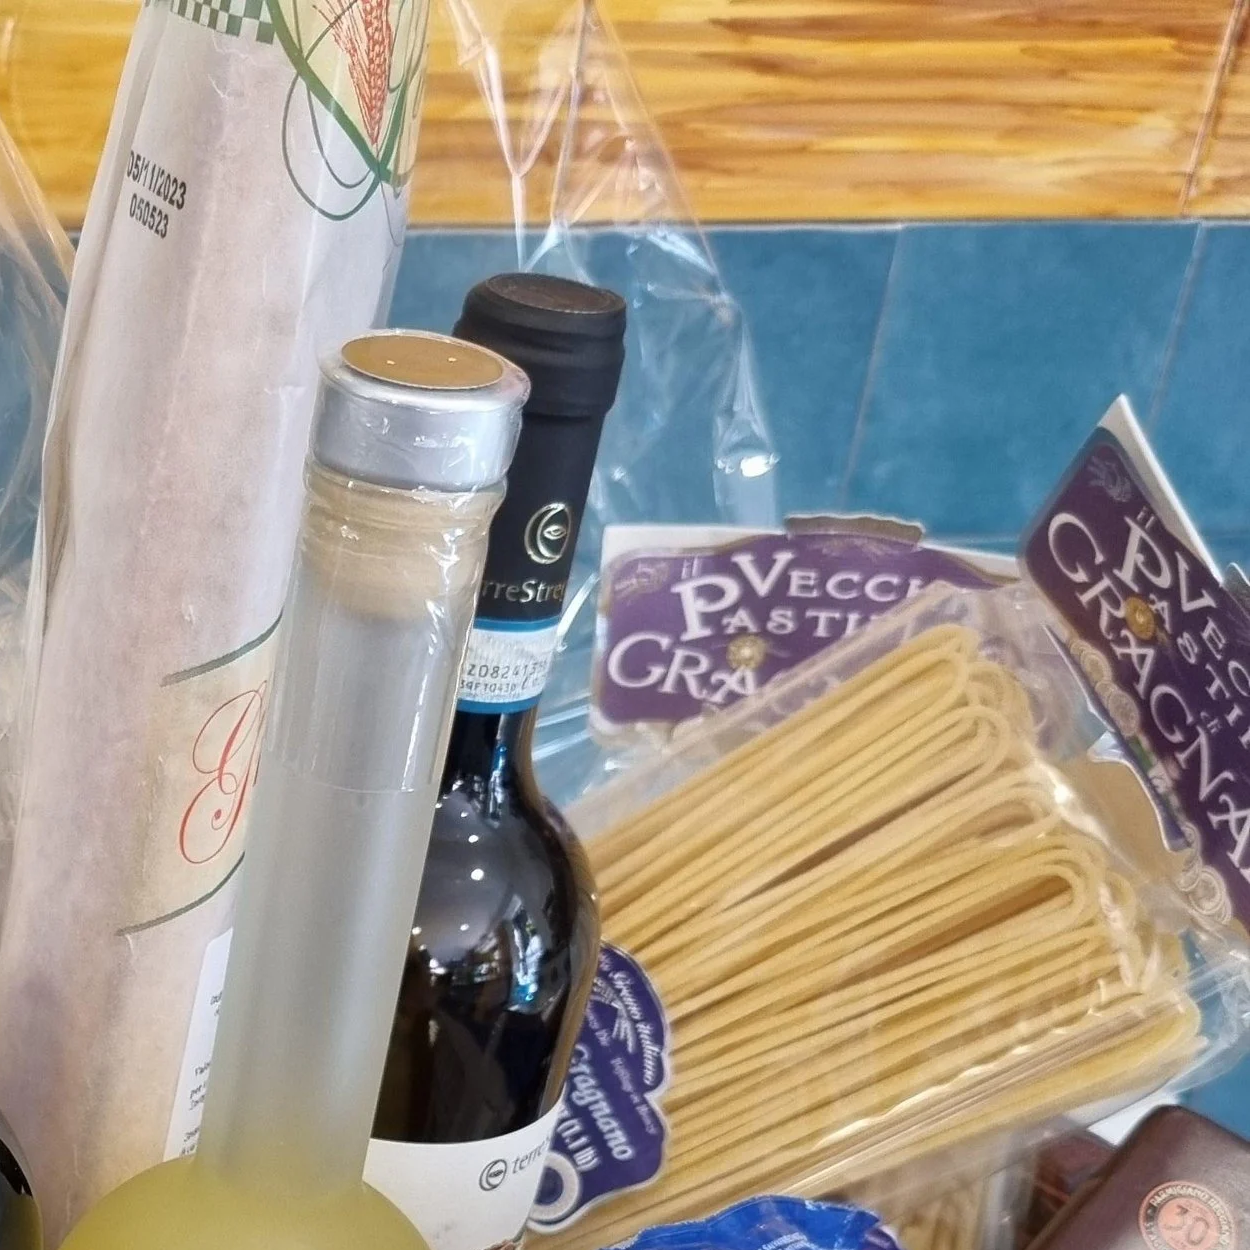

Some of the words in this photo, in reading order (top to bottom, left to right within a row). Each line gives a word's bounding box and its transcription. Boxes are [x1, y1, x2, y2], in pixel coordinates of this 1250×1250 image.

[127, 150, 187, 209] 05/11/2023
[129, 192, 169, 239] 050523
[607, 630, 758, 703] GRA
[1048, 513, 1250, 886] GRAGNA
